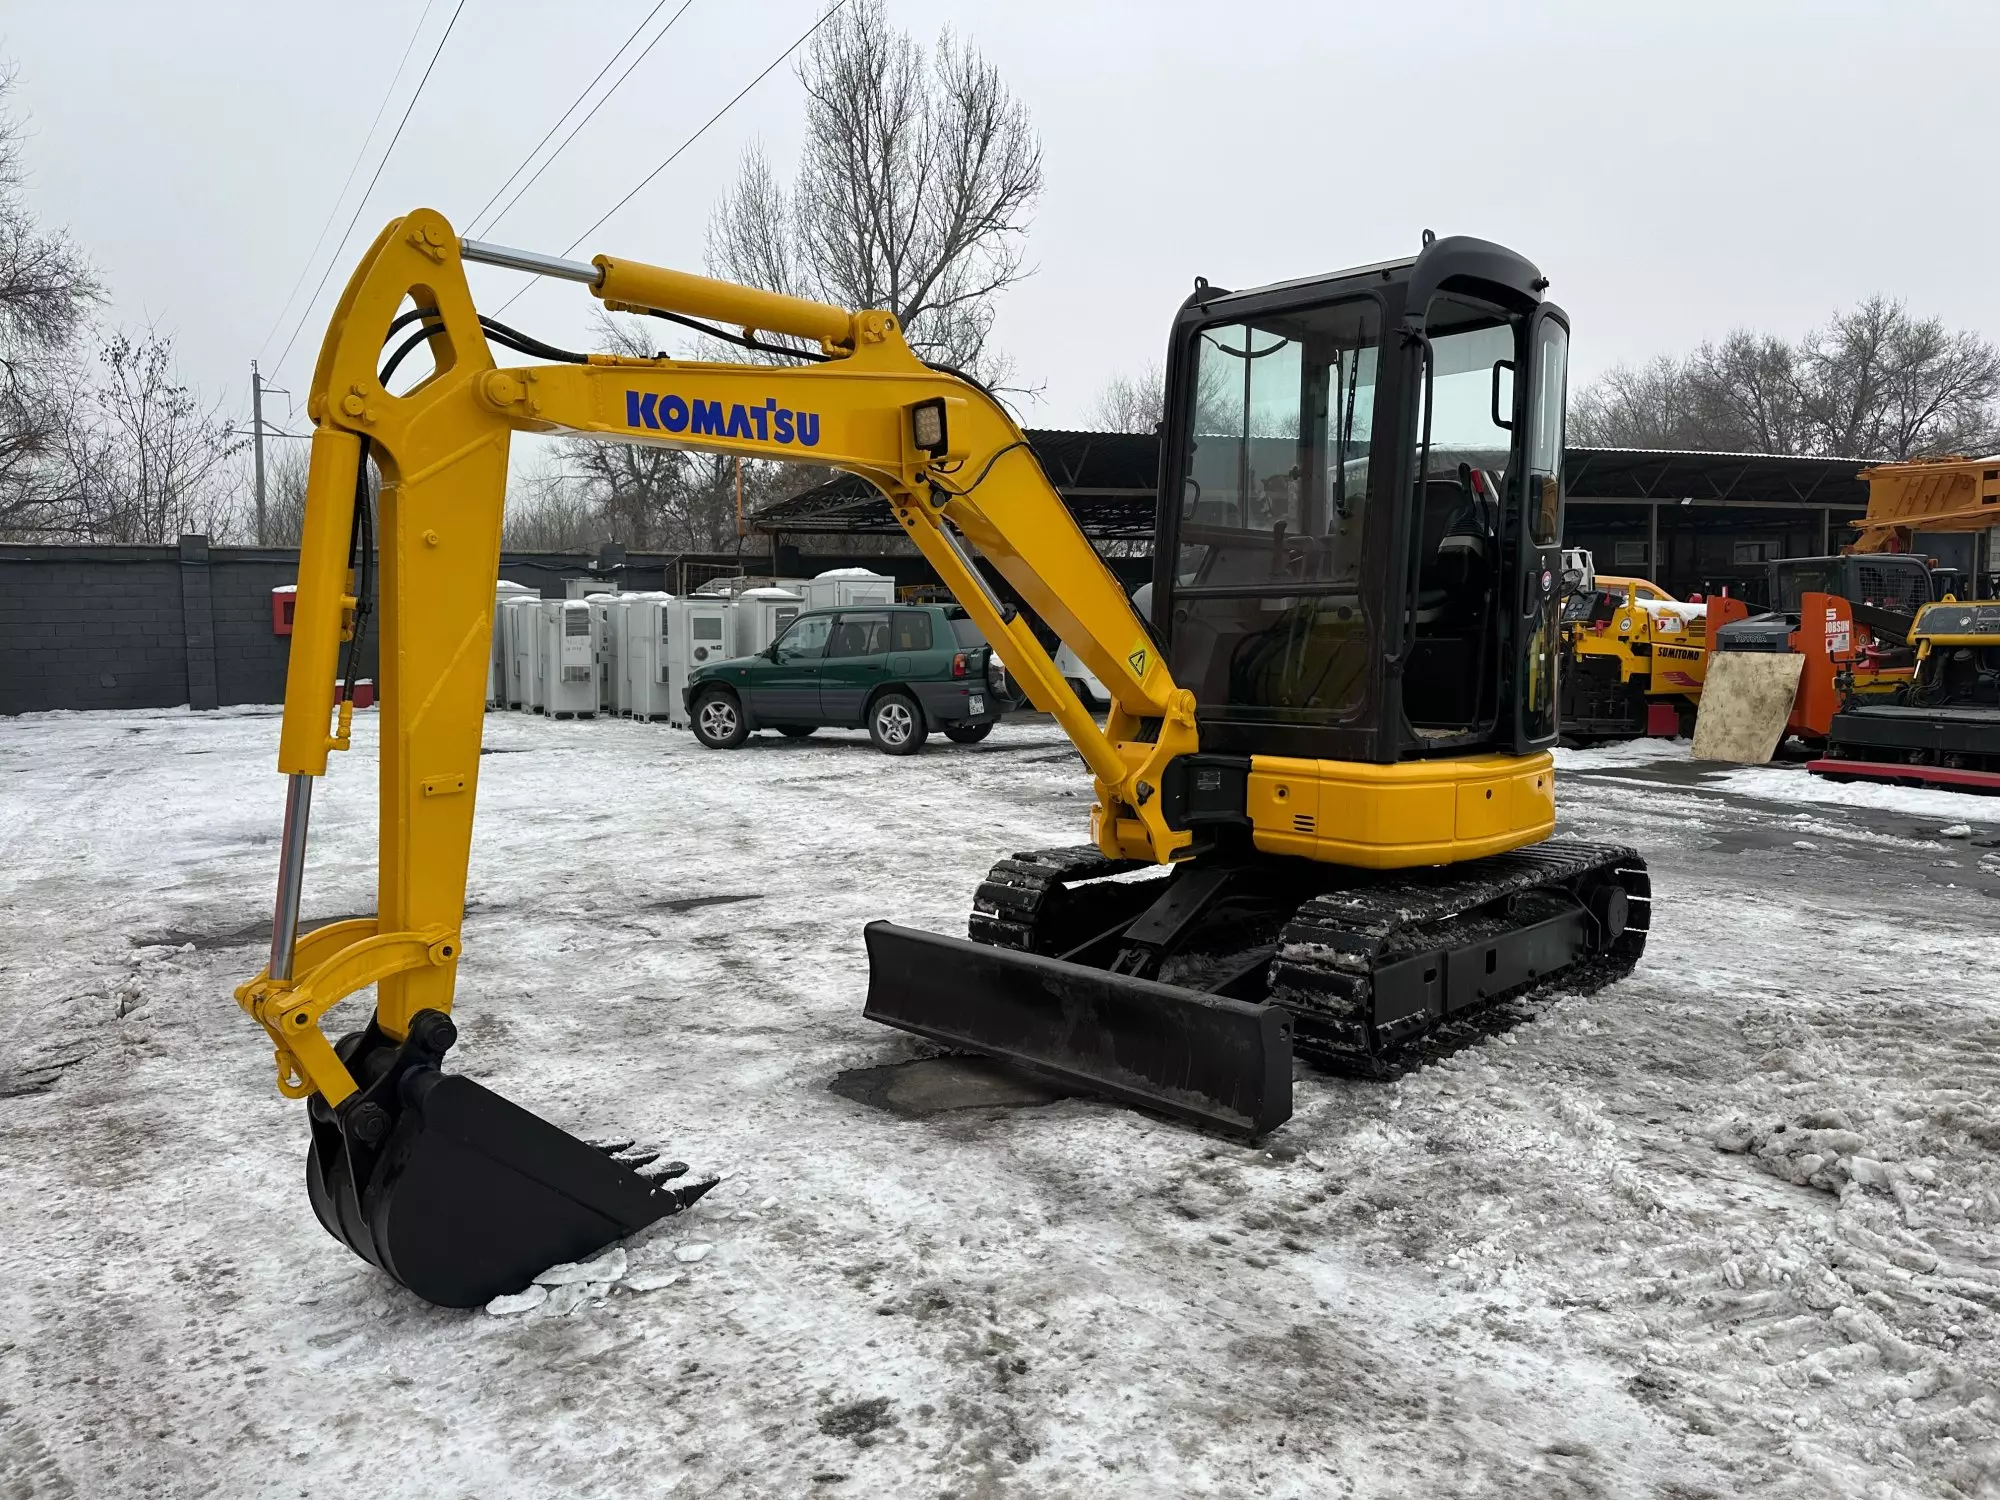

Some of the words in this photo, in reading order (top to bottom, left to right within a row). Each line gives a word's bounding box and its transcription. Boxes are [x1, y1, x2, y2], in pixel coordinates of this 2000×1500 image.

[626, 390, 820, 446] KOMATSU
[1824, 620, 1850, 634] JOBSUN
[1734, 634, 1767, 643] TOYOTA
[1657, 647, 1700, 661] SUMITOMO
